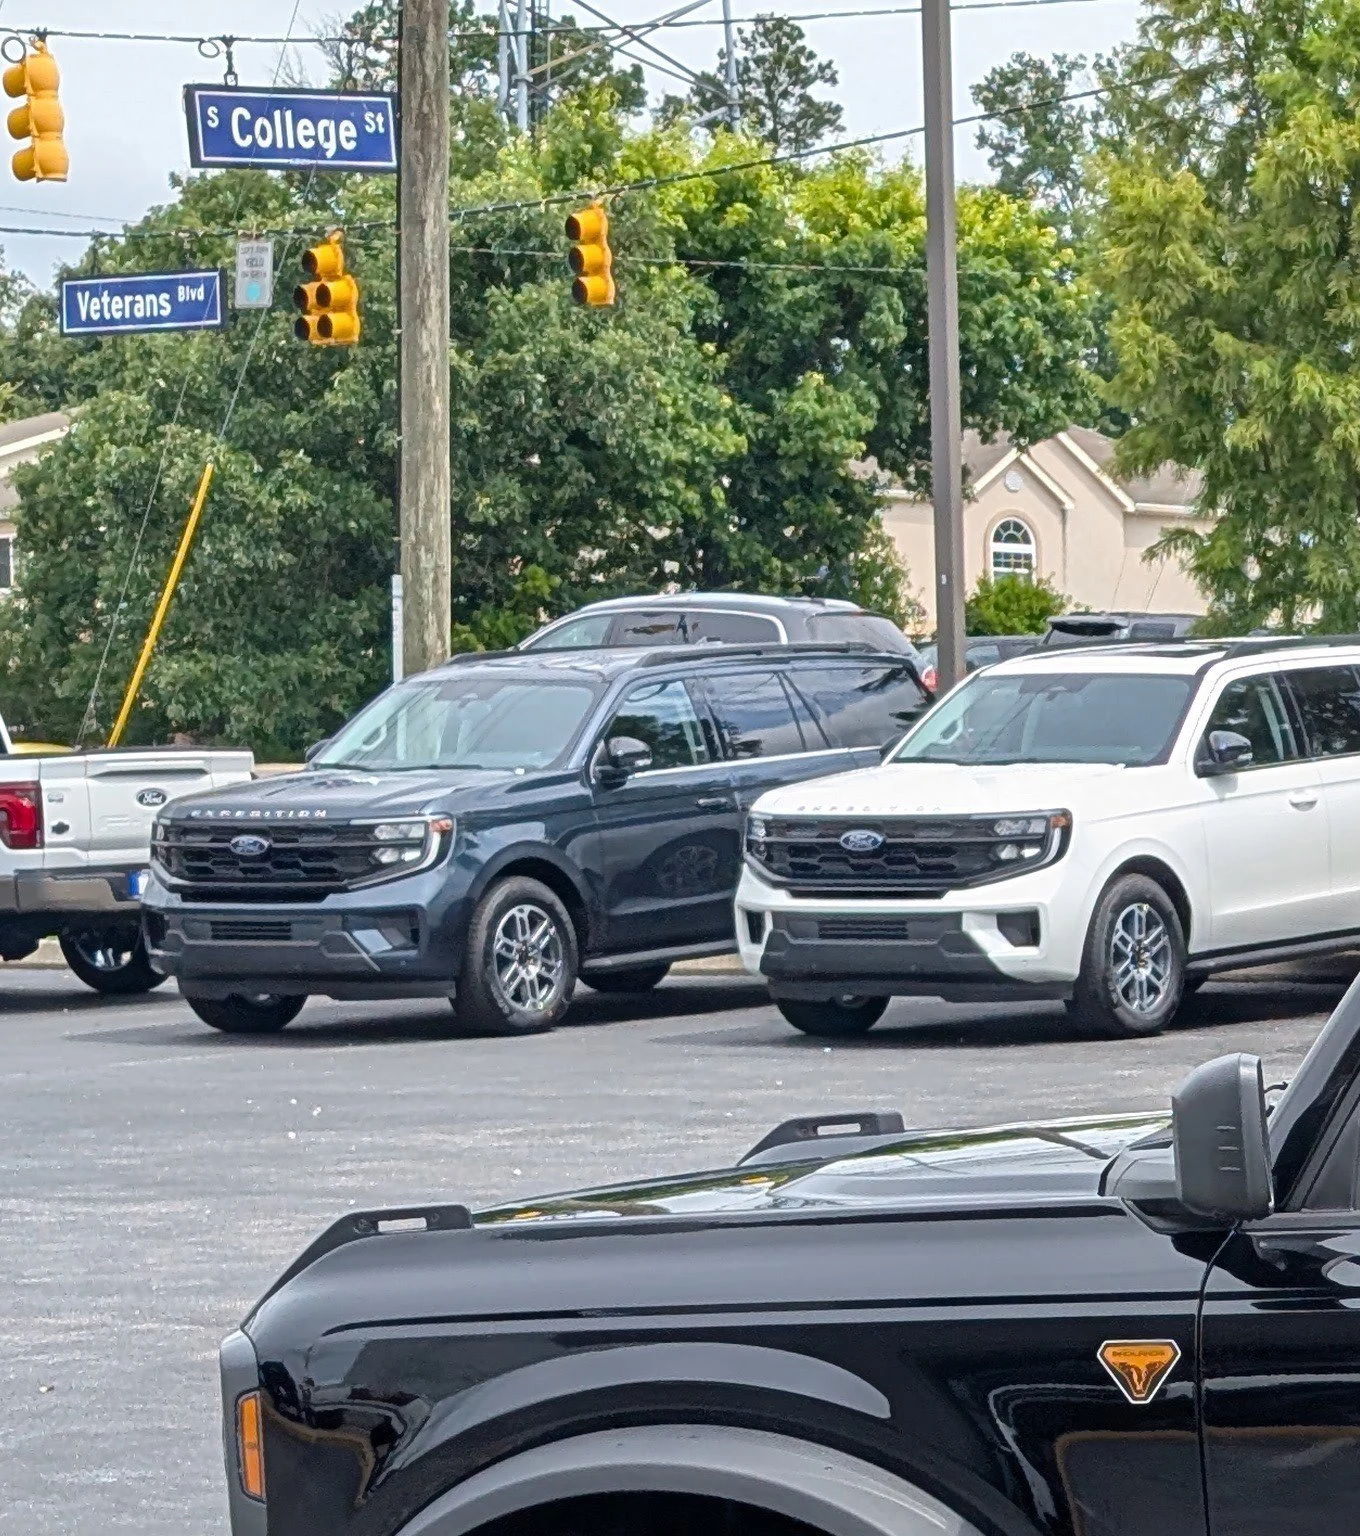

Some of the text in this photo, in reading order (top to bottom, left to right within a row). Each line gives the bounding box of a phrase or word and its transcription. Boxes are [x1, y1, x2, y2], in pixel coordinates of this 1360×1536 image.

[207, 106, 386, 159] S College St
[76, 284, 205, 322] Veterans Blvd
